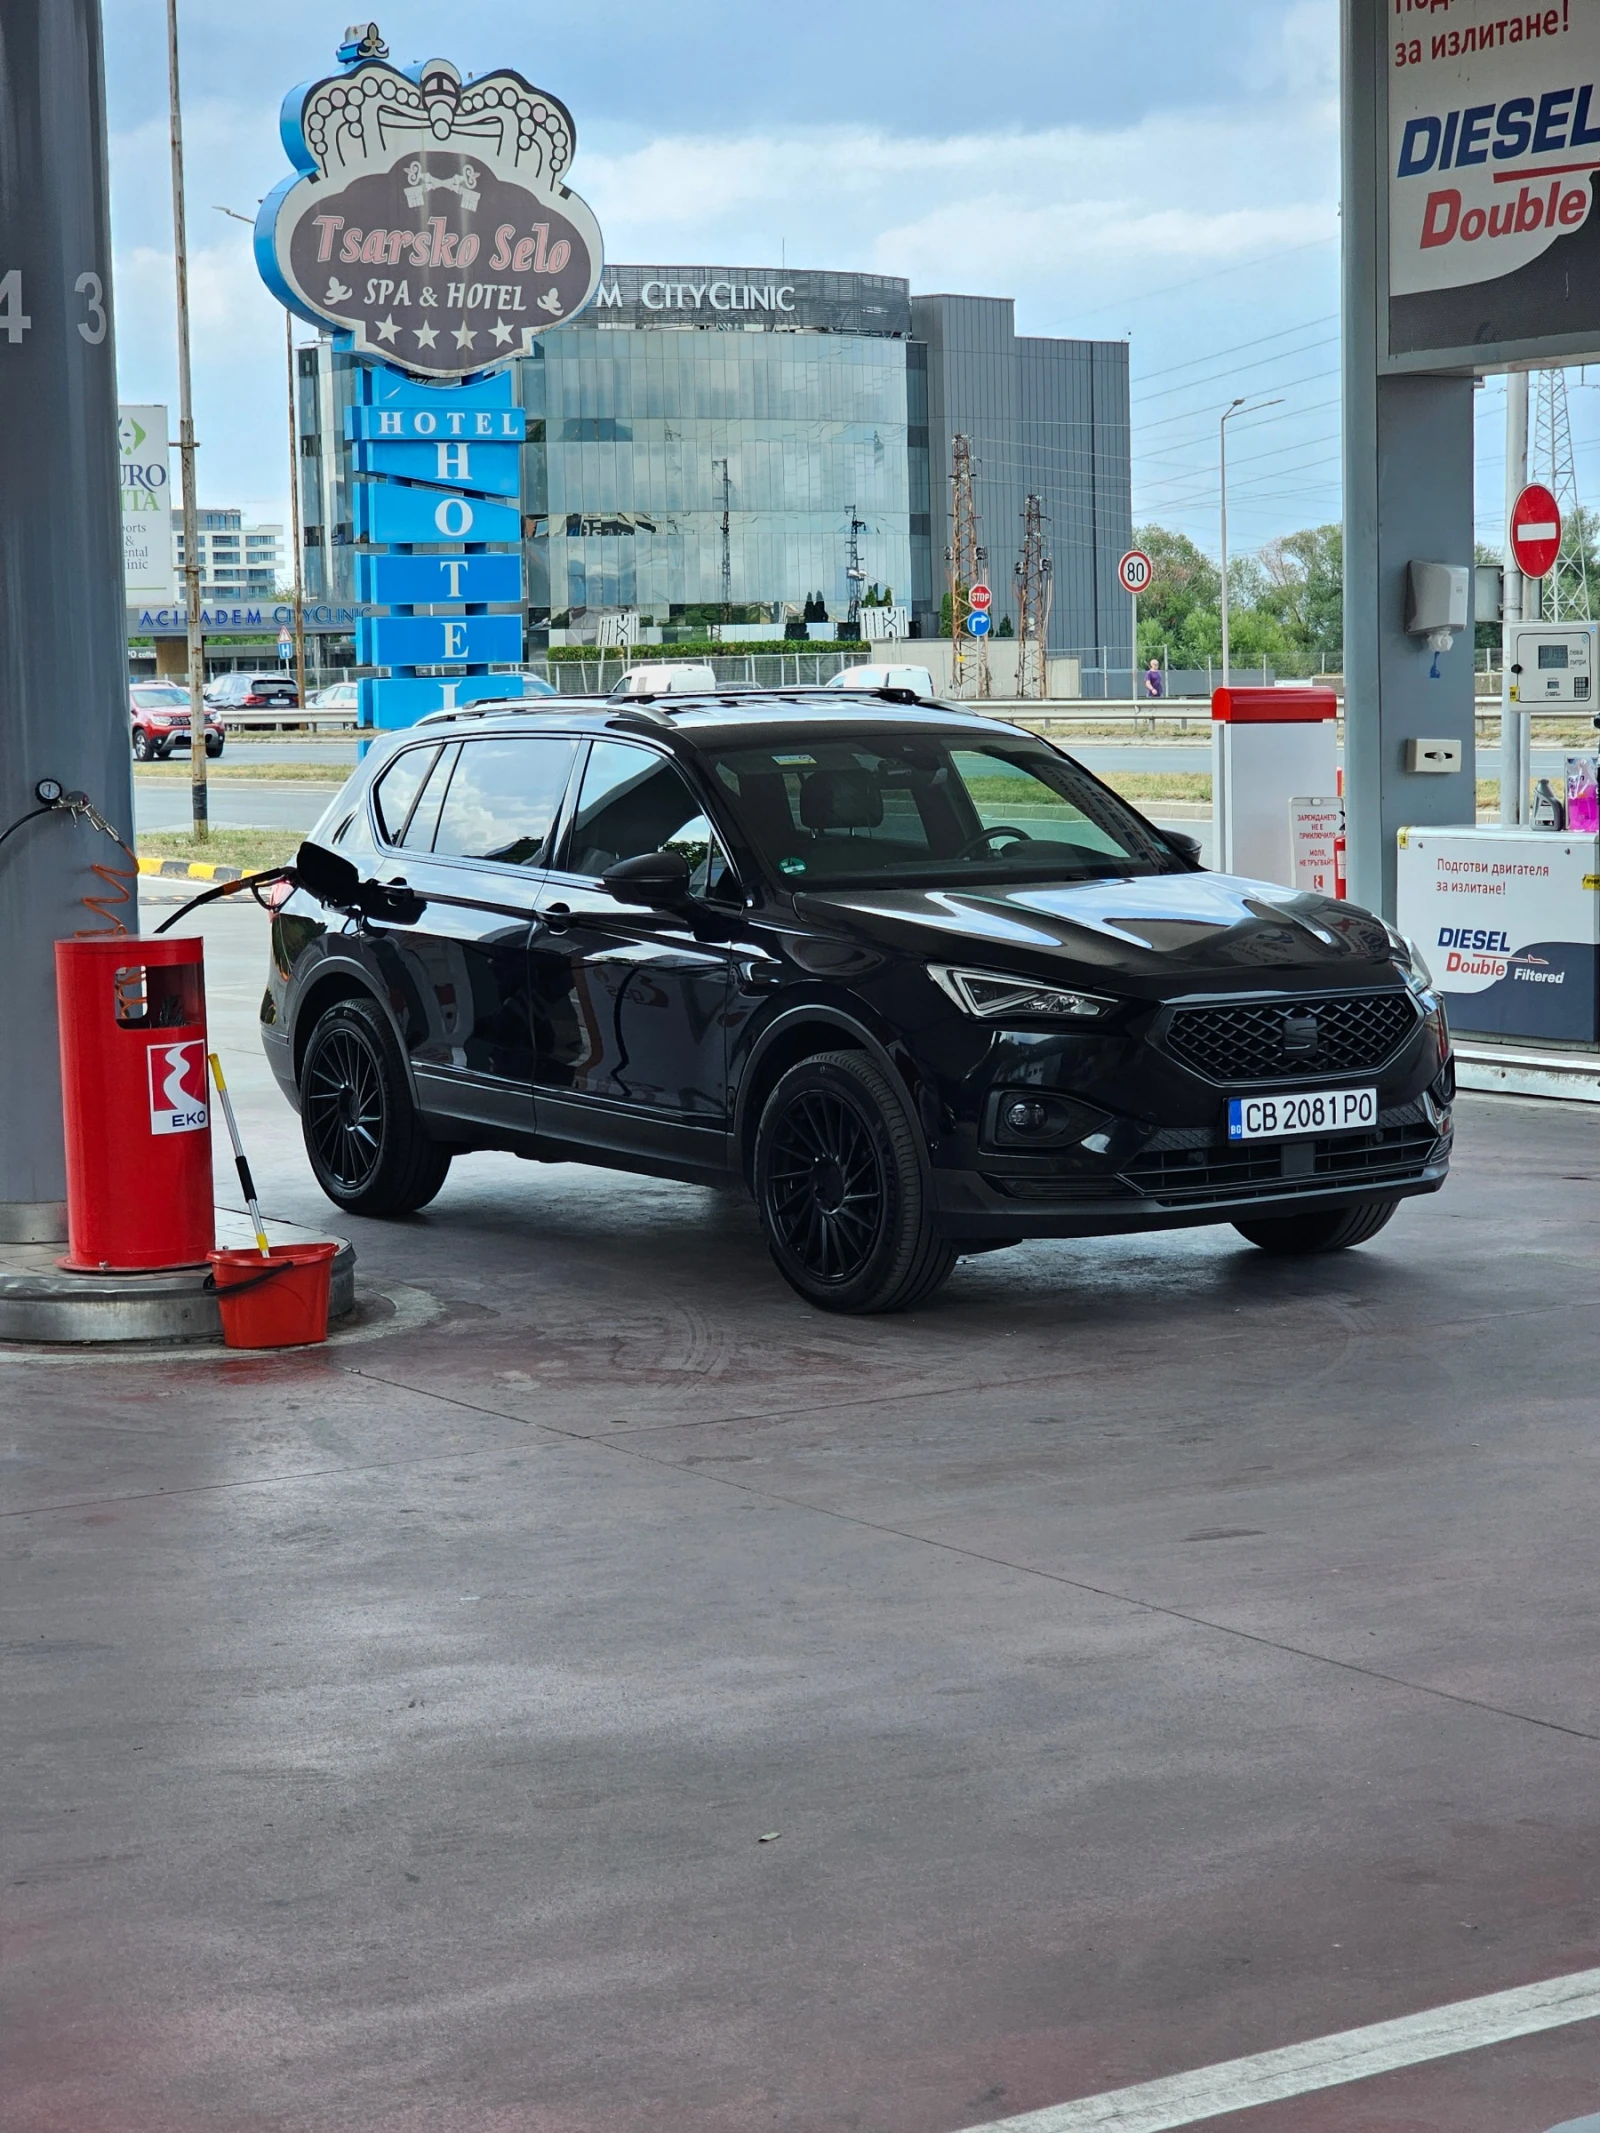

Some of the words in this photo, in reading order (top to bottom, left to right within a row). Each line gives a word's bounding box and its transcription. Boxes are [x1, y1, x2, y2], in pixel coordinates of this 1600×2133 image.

[1394, 39, 1422, 68] за
[1431, 0, 1570, 61] излитане!
[1397, 84, 1600, 179] DIESEL
[1419, 181, 1588, 250] Double
[312, 214, 480, 269] Tsarsko
[489, 223, 572, 274] Selo
[363, 278, 412, 307] SPA
[419, 286, 439, 308] &
[446, 282, 527, 311] HOTEL
[74, 271, 107, 345] 3
[377, 411, 519, 435] HOTEL
[1127, 562, 1145, 582] 80
[971, 592, 990, 603] STOP
[140, 609, 262, 625] ACIADEM
[1437, 858, 1489, 874] Подготви
[1491, 863, 1550, 877] двигателя
[1436, 880, 1449, 892] за
[1451, 881, 1507, 896] излитане!
[1437, 927, 1511, 952] DIESEL
[1446, 952, 1506, 976] Double
[1513, 967, 1566, 984] Filtered
[171, 1110, 207, 1128] EKO
[1246, 1102, 1278, 1133] CB
[1283, 1096, 1337, 1129] 2081
[1344, 1093, 1373, 1124] PO
[1230, 1125, 1242, 1135] BG
